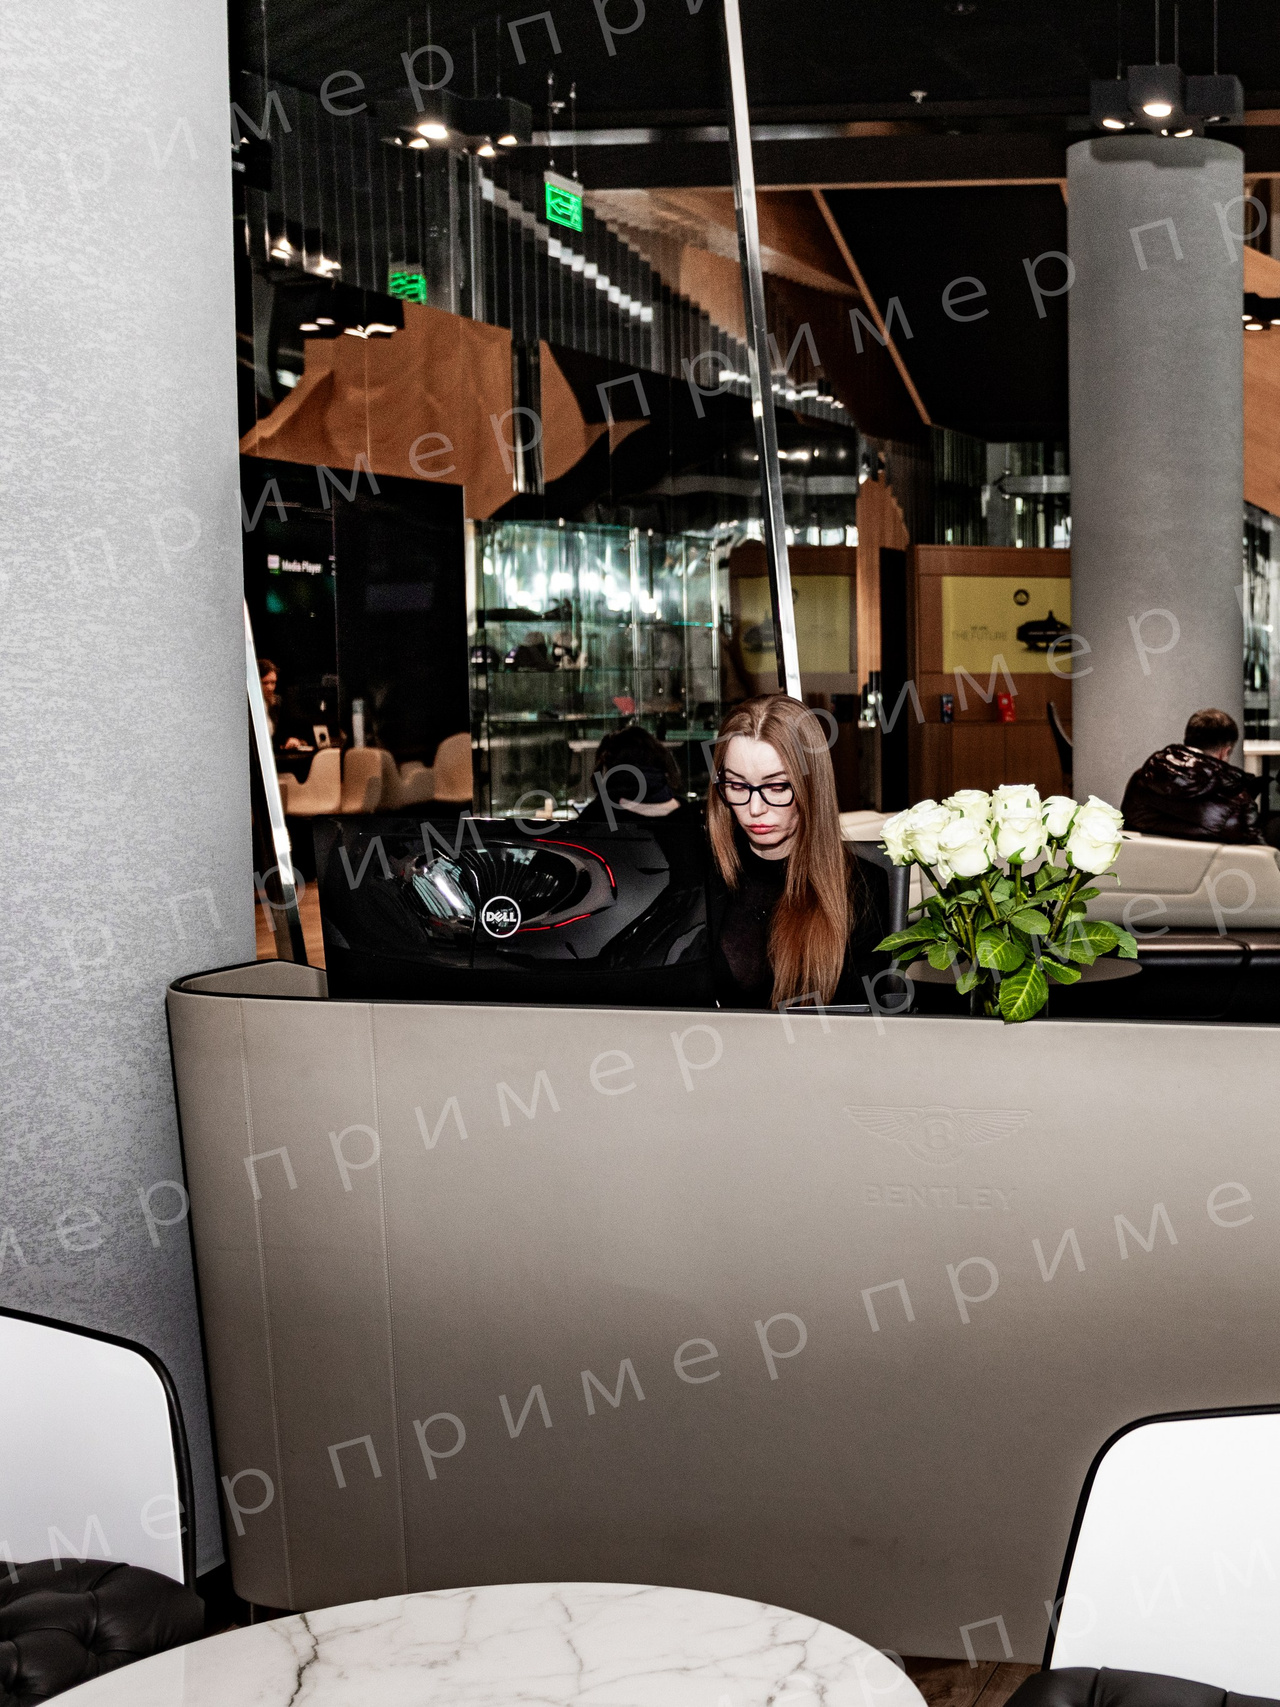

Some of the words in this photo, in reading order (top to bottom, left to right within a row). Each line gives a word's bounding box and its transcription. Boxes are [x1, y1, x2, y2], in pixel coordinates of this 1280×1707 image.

[281, 559, 302, 573] Media
[302, 560, 322, 575] Player
[486, 911, 517, 923] DELL
[864, 1182, 1018, 1210] BENTLEY
